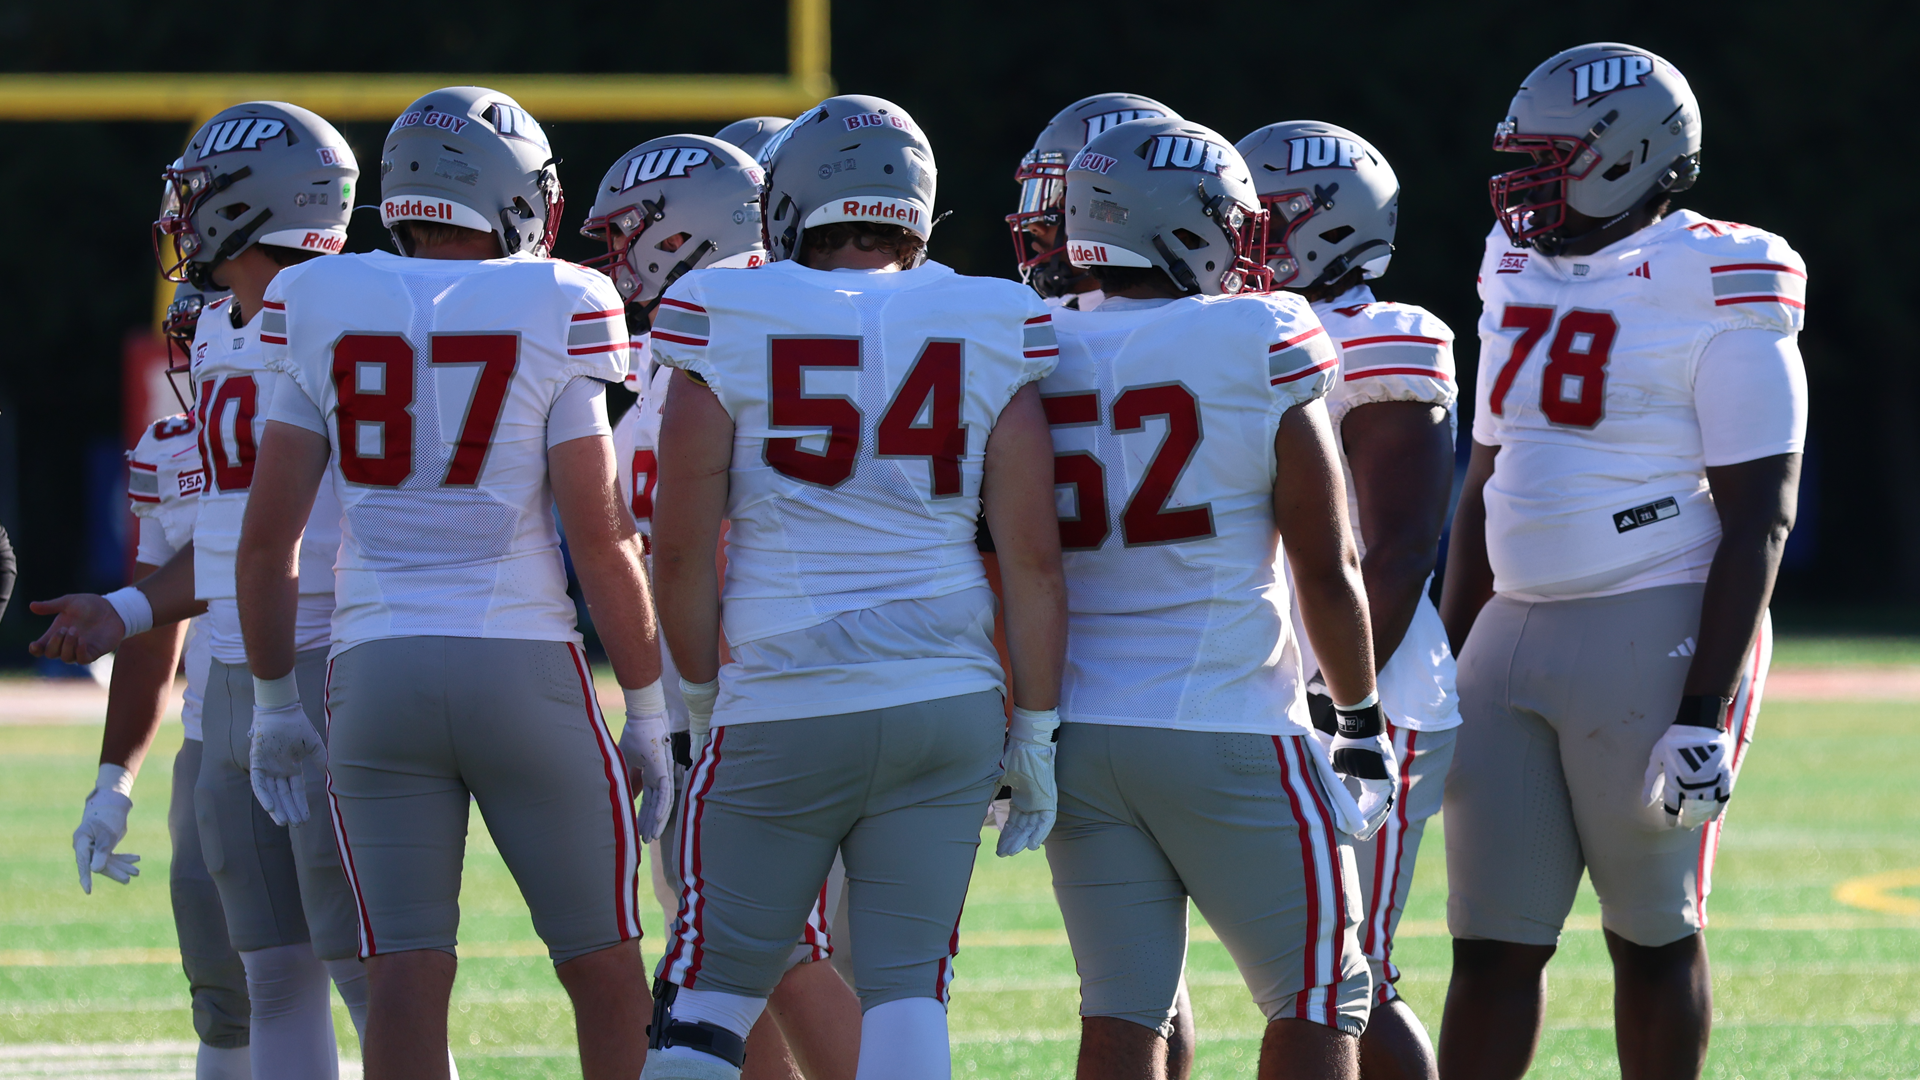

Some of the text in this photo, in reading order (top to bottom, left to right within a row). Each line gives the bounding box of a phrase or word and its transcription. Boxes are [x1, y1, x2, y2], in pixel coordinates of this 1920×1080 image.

[1574, 55, 1654, 102] IUP
[424, 112, 468, 134] GUY
[846, 113, 918, 133] BIG GU
[199, 118, 287, 160] IUP
[1081, 153, 1115, 173] GUY
[1151, 136, 1231, 175] IUP
[1288, 136, 1364, 173] IUP
[621, 147, 711, 193] IUP
[386, 201, 453, 220] Riddell
[843, 201, 919, 225] Riddell
[302, 232, 345, 252] Ridde
[1071, 245, 1108, 262] ddell
[1500, 258, 1528, 269] PSAC
[1489, 302, 1621, 431] 78
[331, 330, 522, 489] 87
[761, 334, 969, 500] 54
[1039, 379, 1217, 552] 52
[179, 475, 202, 490] PSA
